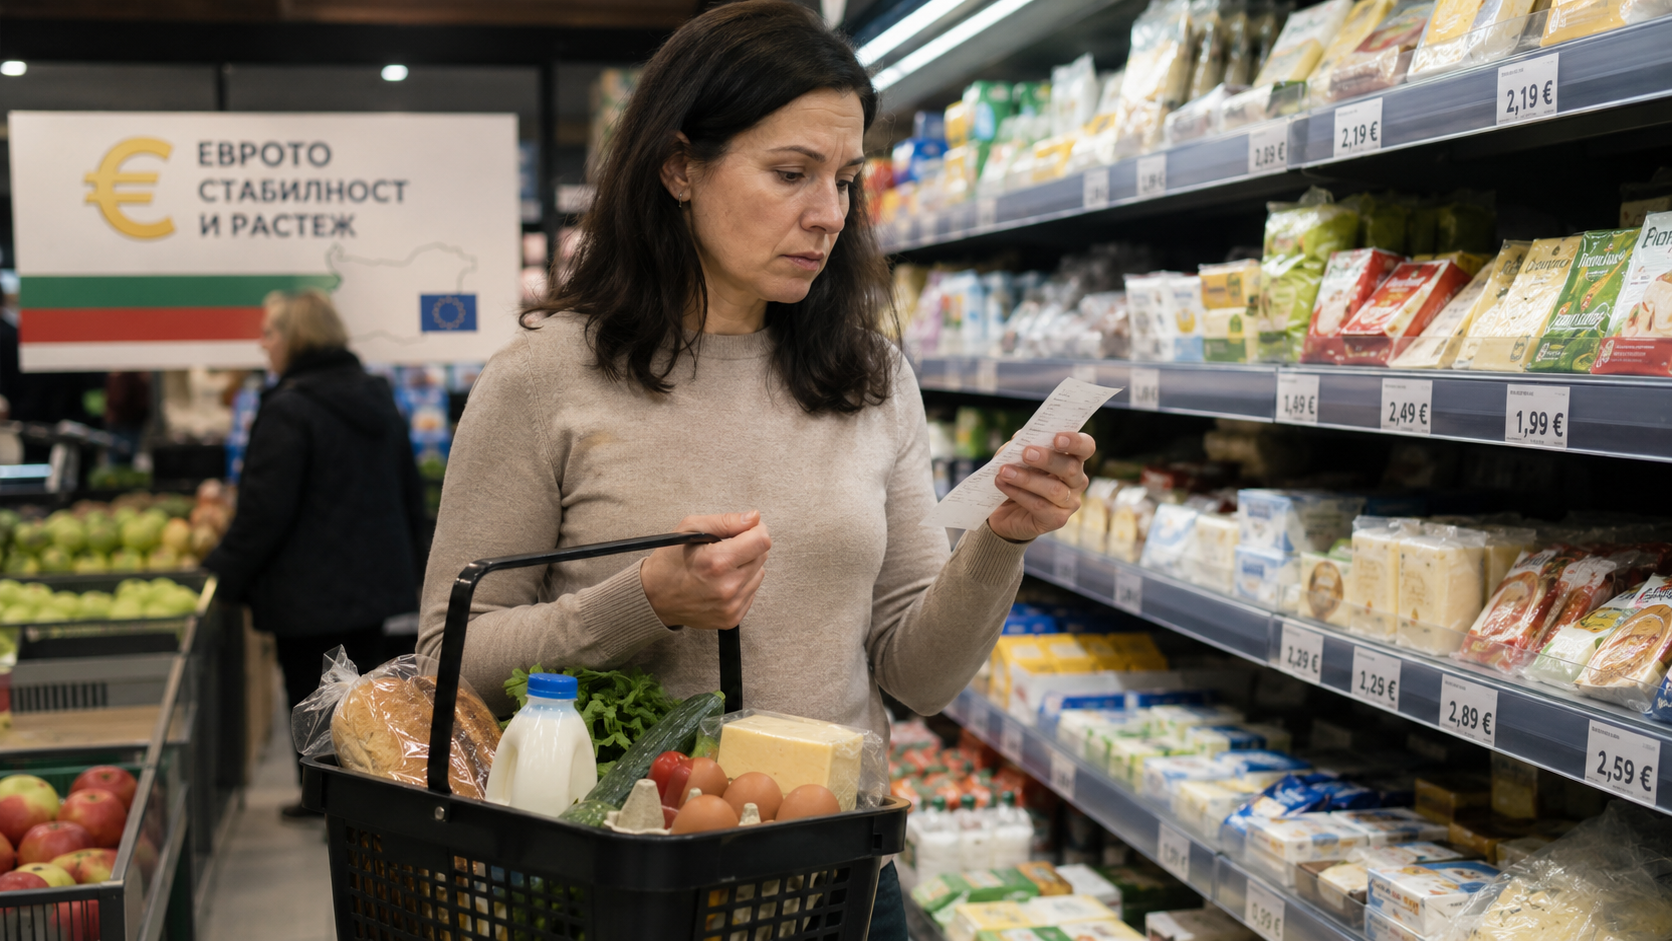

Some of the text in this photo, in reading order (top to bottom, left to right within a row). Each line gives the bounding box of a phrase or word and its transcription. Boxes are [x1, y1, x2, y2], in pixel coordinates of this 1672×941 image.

[1506, 83, 1538, 116] 2,19
[1542, 79, 1553, 105] €
[1342, 120, 1378, 151] 2,19 €
[198, 141, 333, 169] ЕВРОТО
[198, 178, 409, 205] СТАБИЛНОСТ
[199, 213, 358, 239] И РАСТЕЖ
[1284, 394, 1315, 417] 1,49 €
[1388, 401, 1428, 426] 2,49 €
[1516, 410, 1564, 438] 1,99 €
[1287, 645, 1319, 674] 2,29 €
[1388, 680, 1396, 702] €
[1448, 700, 1478, 729] 2,89
[1482, 712, 1492, 735] €
[1596, 750, 1635, 784] 2,59
[1639, 765, 1653, 792] €
